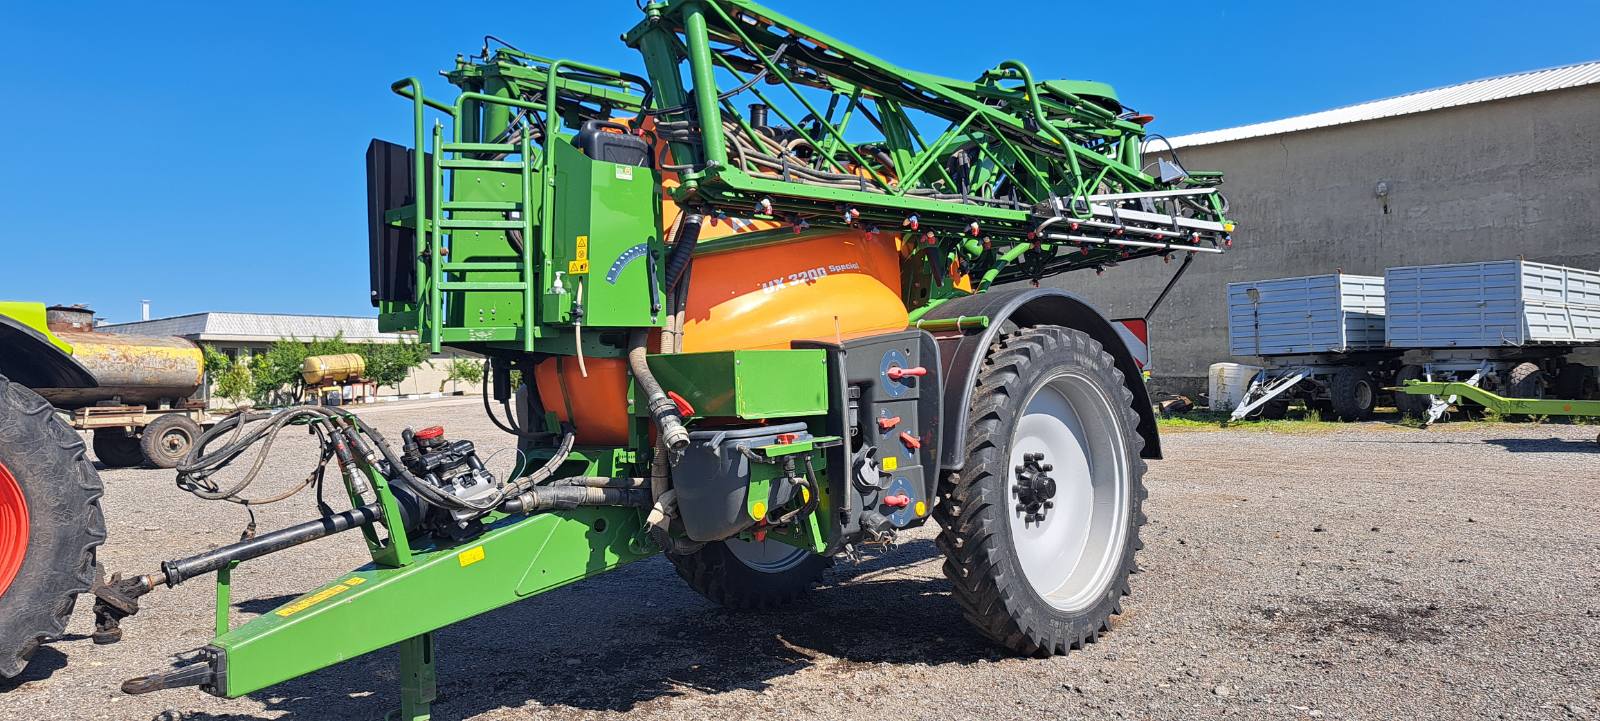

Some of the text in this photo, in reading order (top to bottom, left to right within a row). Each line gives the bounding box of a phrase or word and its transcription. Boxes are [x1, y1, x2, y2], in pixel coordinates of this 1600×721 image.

[762, 262, 860, 293] UX 3200 Special
